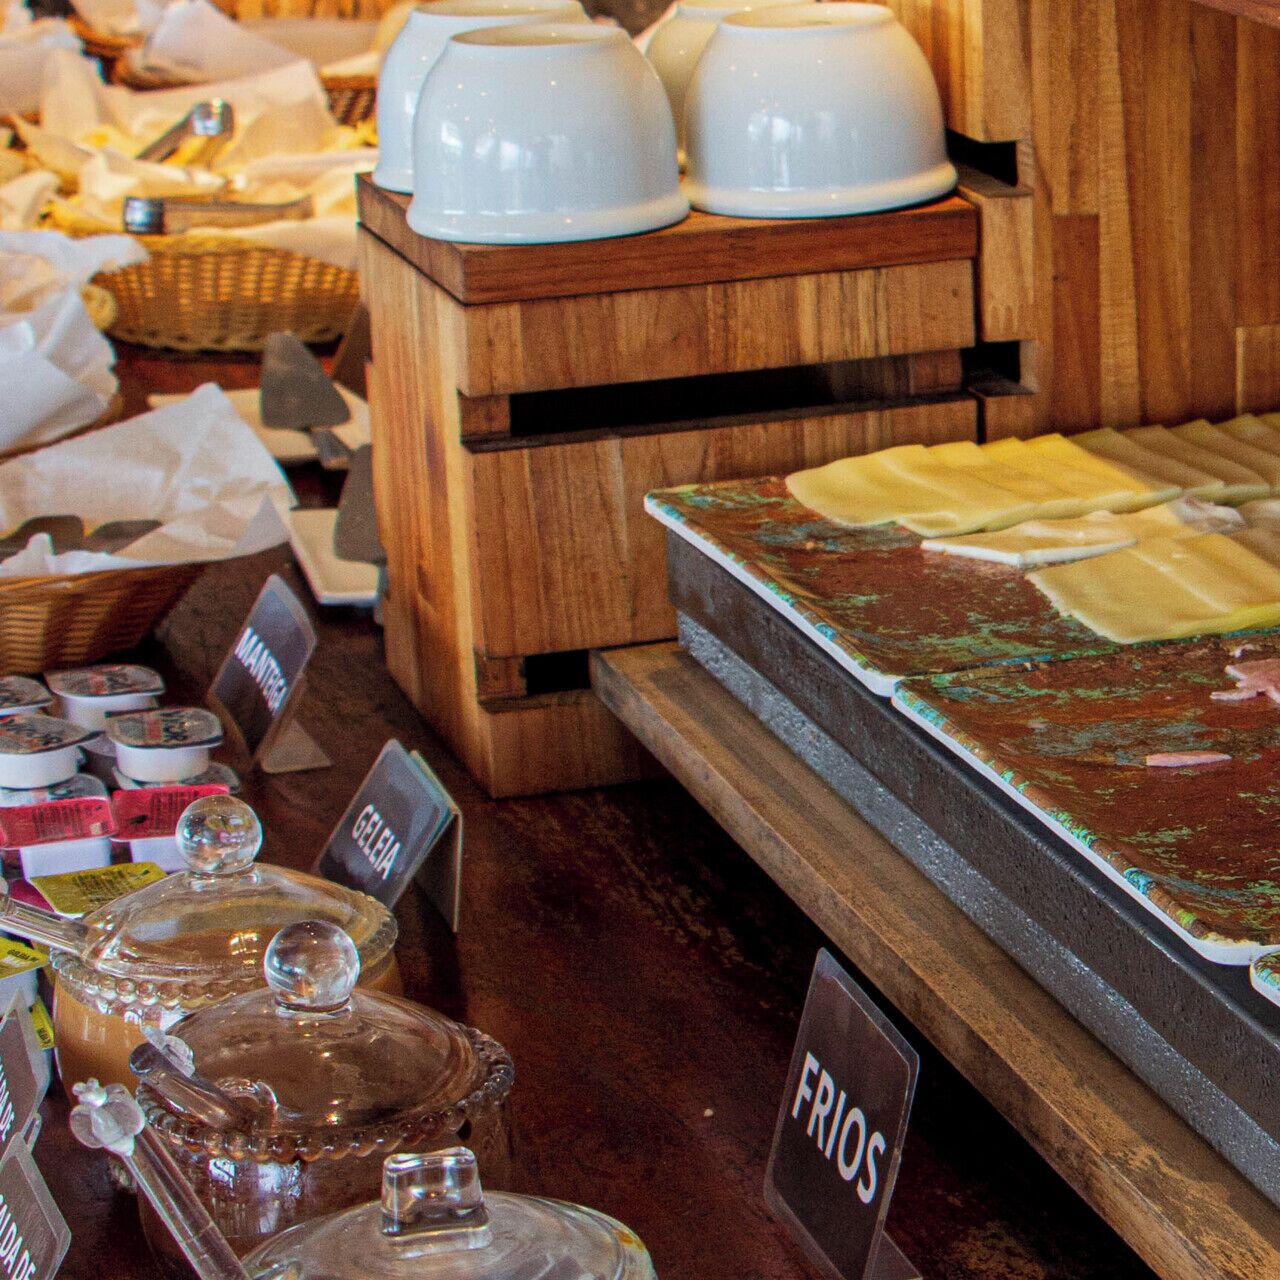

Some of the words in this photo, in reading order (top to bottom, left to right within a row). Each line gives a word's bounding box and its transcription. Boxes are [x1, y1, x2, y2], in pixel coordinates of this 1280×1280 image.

[235, 626, 289, 716] MANTEIGA
[351, 803, 401, 881] GELEIA
[791, 1049, 887, 1205] FRIOS
